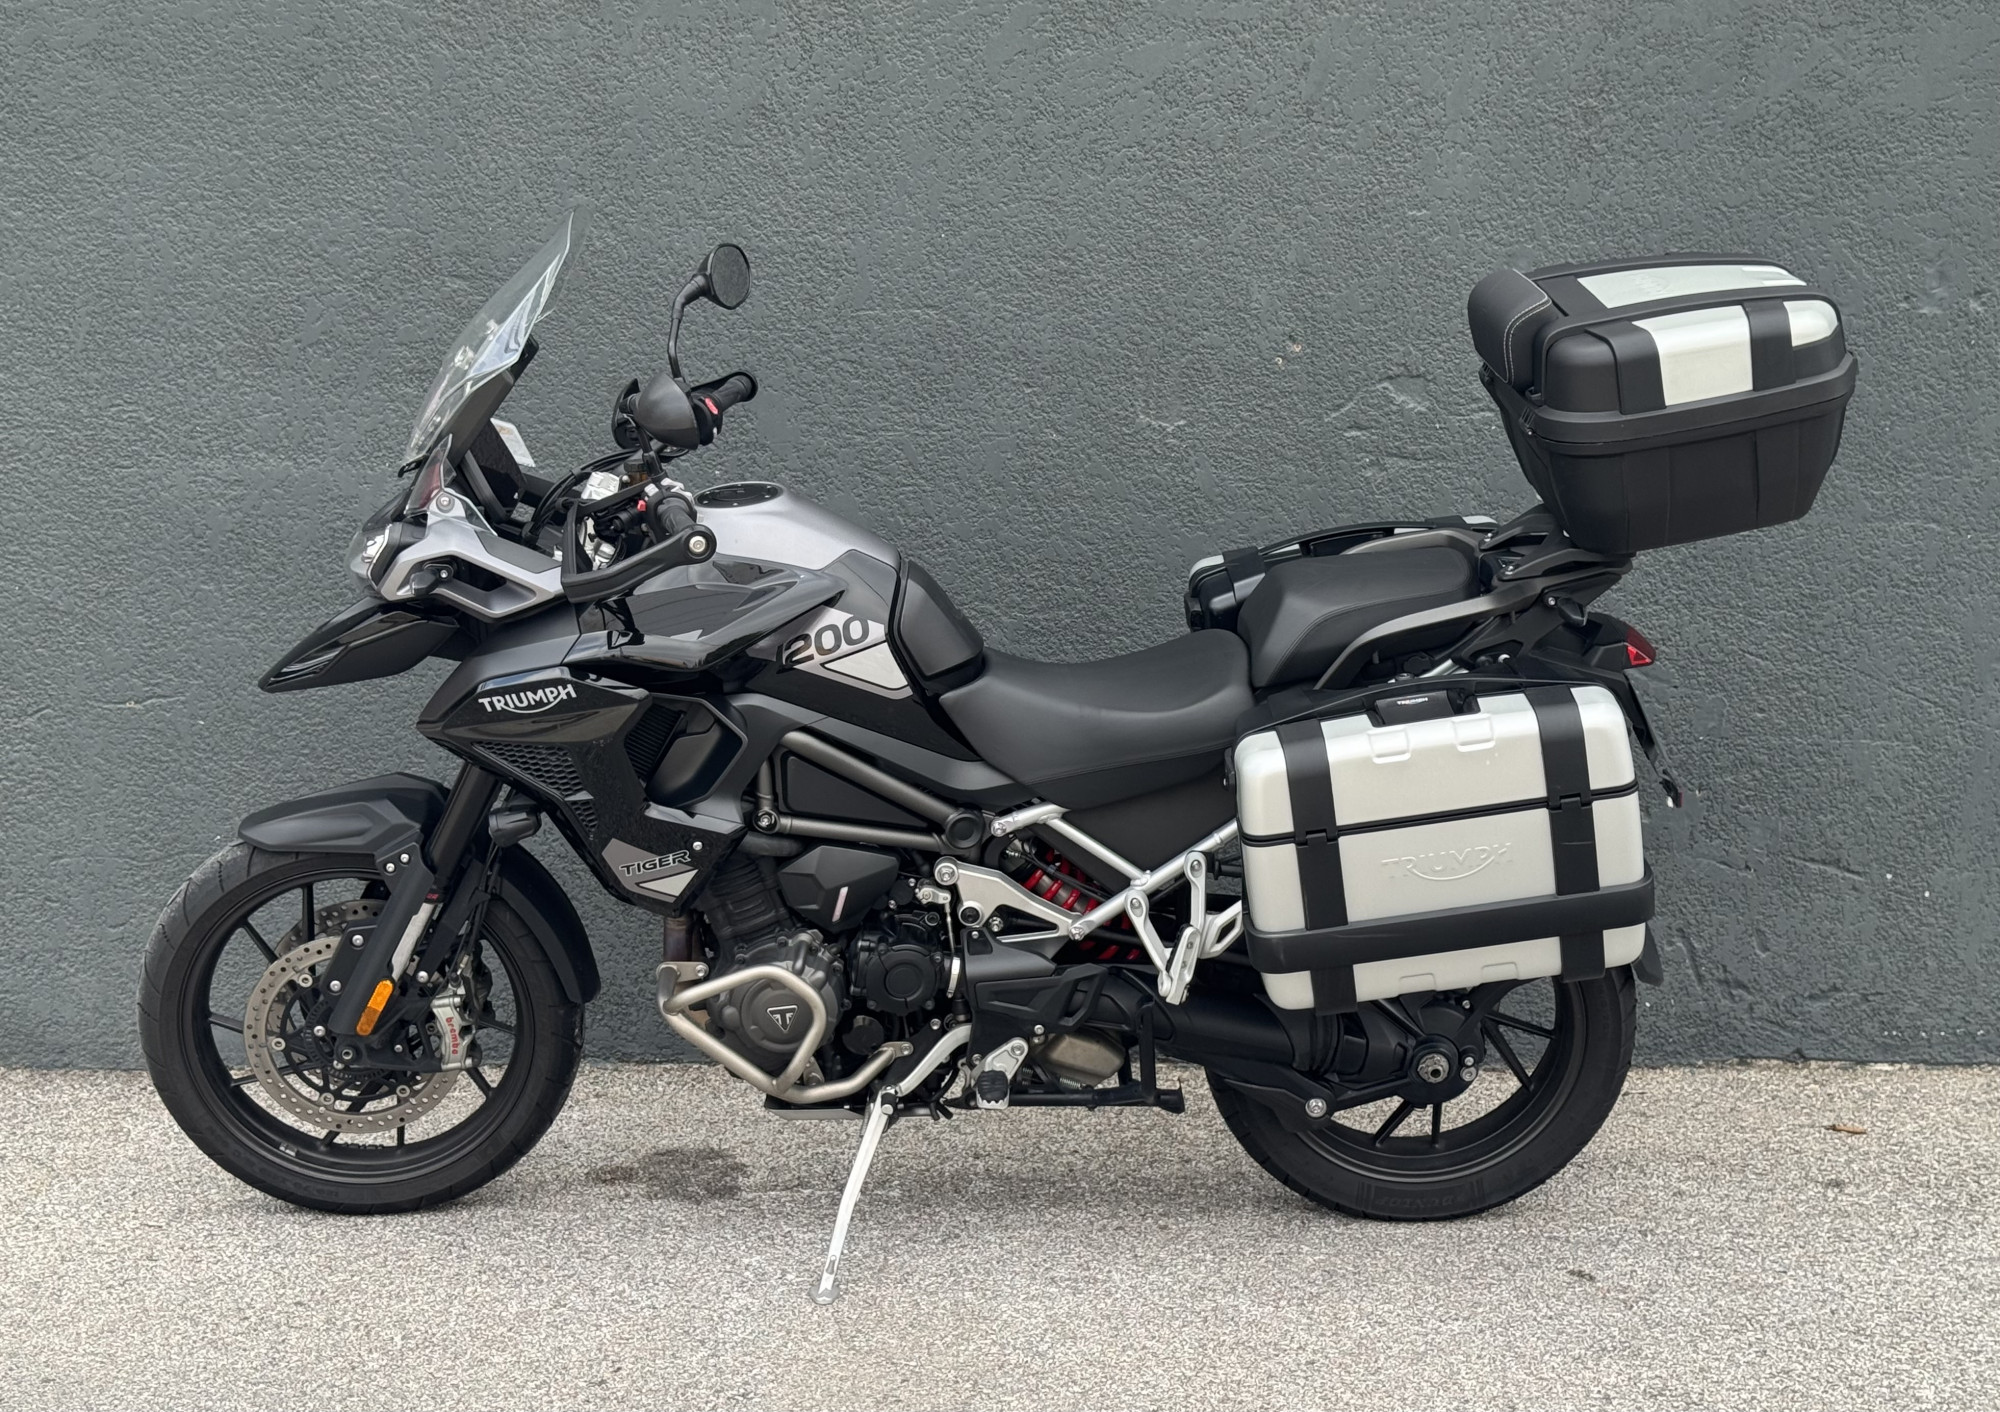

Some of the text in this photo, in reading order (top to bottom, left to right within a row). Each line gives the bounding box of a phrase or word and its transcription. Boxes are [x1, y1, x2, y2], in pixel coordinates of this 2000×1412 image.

[478, 683, 577, 713] TRIUMPH
[619, 849, 691, 877] TIGER
[445, 1016, 460, 1055] brembo
